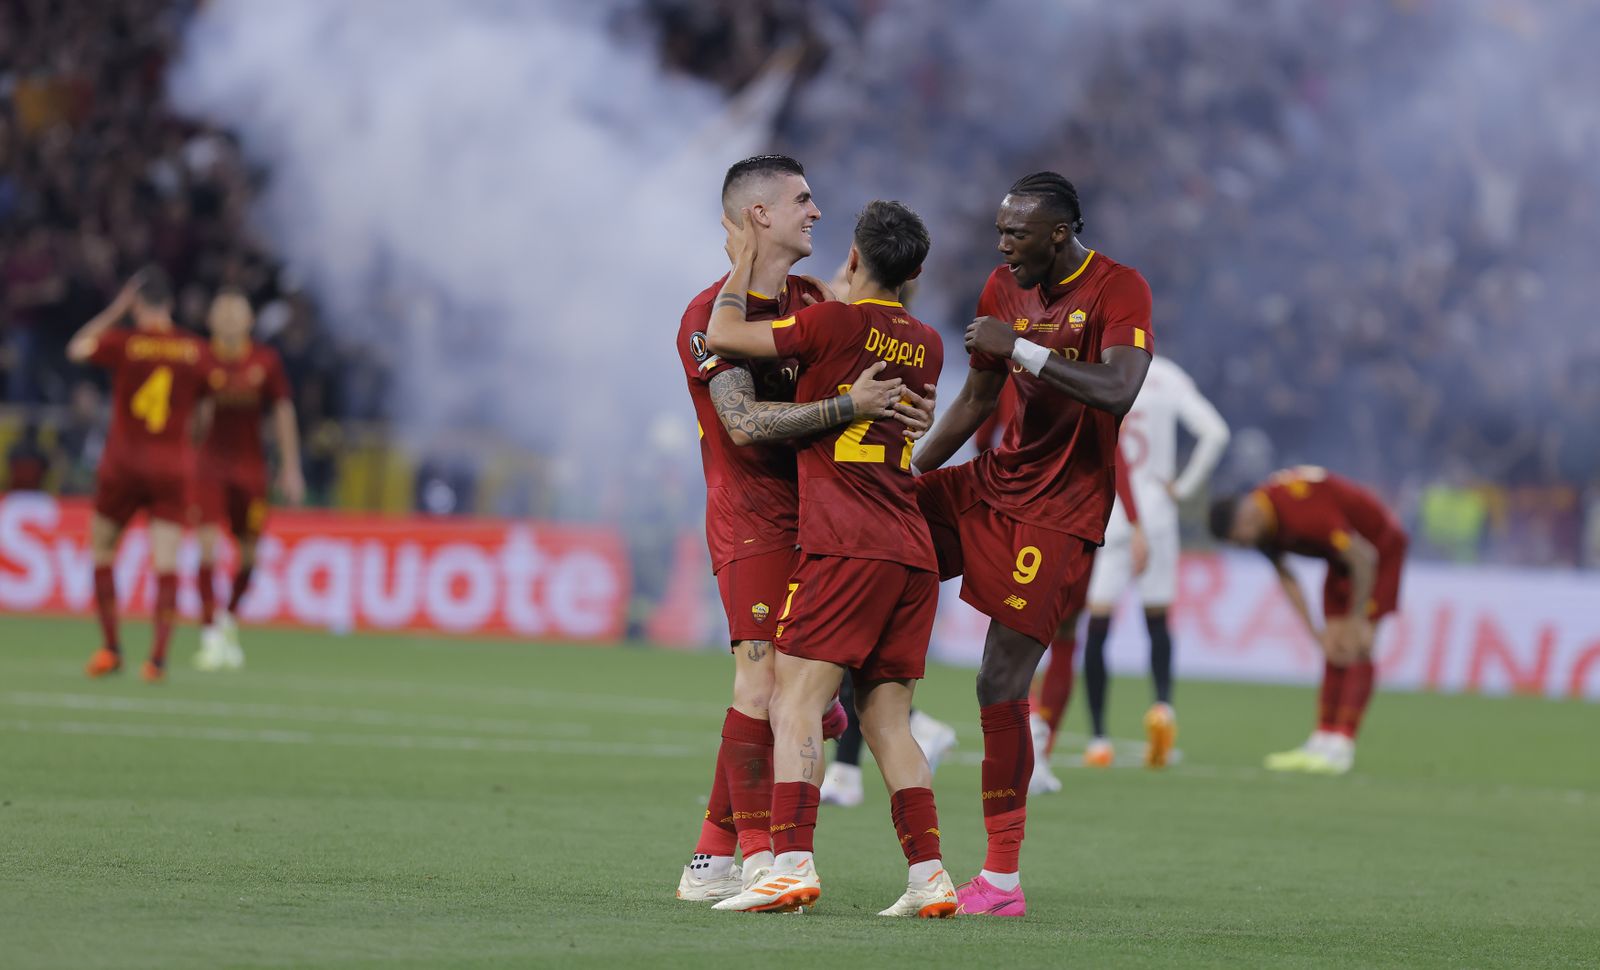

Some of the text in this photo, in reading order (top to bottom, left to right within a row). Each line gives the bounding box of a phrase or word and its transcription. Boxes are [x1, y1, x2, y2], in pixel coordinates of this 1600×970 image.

[865, 327, 925, 368] DYBALA
[130, 366, 172, 434] 4
[0, 488, 620, 634] Swssquote
[1012, 545, 1042, 585] 9
